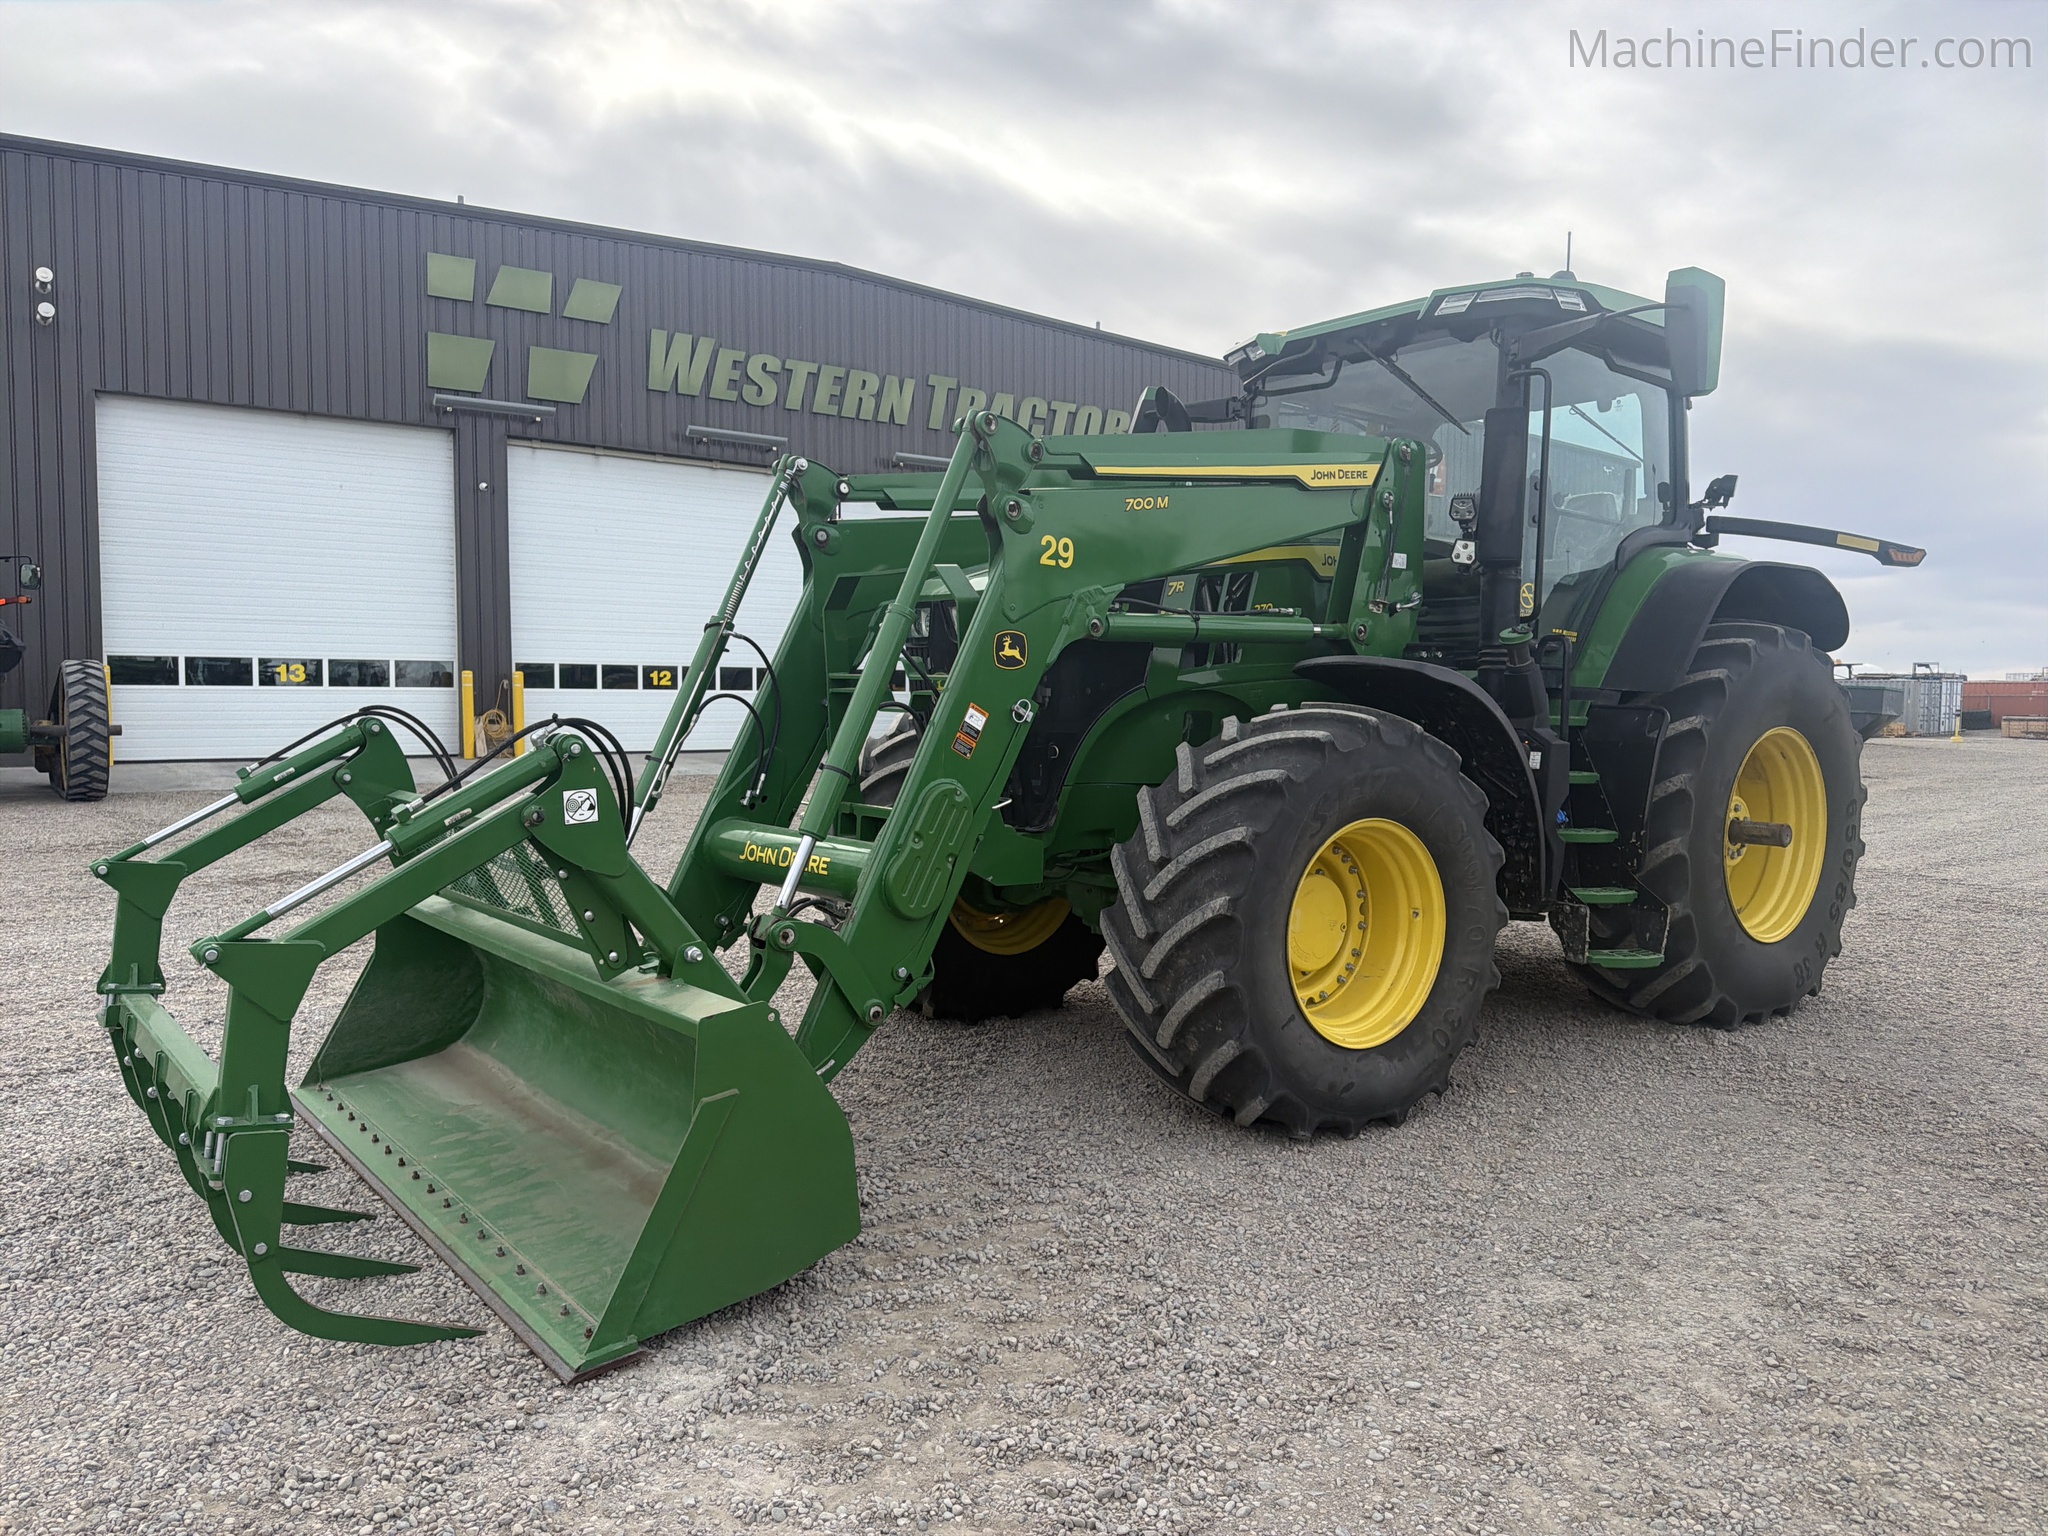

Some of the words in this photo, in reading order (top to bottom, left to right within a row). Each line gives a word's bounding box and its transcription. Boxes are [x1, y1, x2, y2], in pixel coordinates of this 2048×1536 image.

[648, 328, 915, 426] WESTERN
[928, 374, 1131, 436] TRACTOR
[1311, 469, 1336, 480] JOHN
[1337, 468, 1368, 479] DEERE
[1124, 497, 1154, 511] 700
[1156, 496, 1169, 509] M
[1040, 534, 1074, 569] 29
[1167, 580, 1186, 597] 7R
[275, 663, 307, 683] 13
[649, 670, 672, 686] 12
[739, 840, 778, 866] JOHN
[779, 846, 831, 875] DRE
